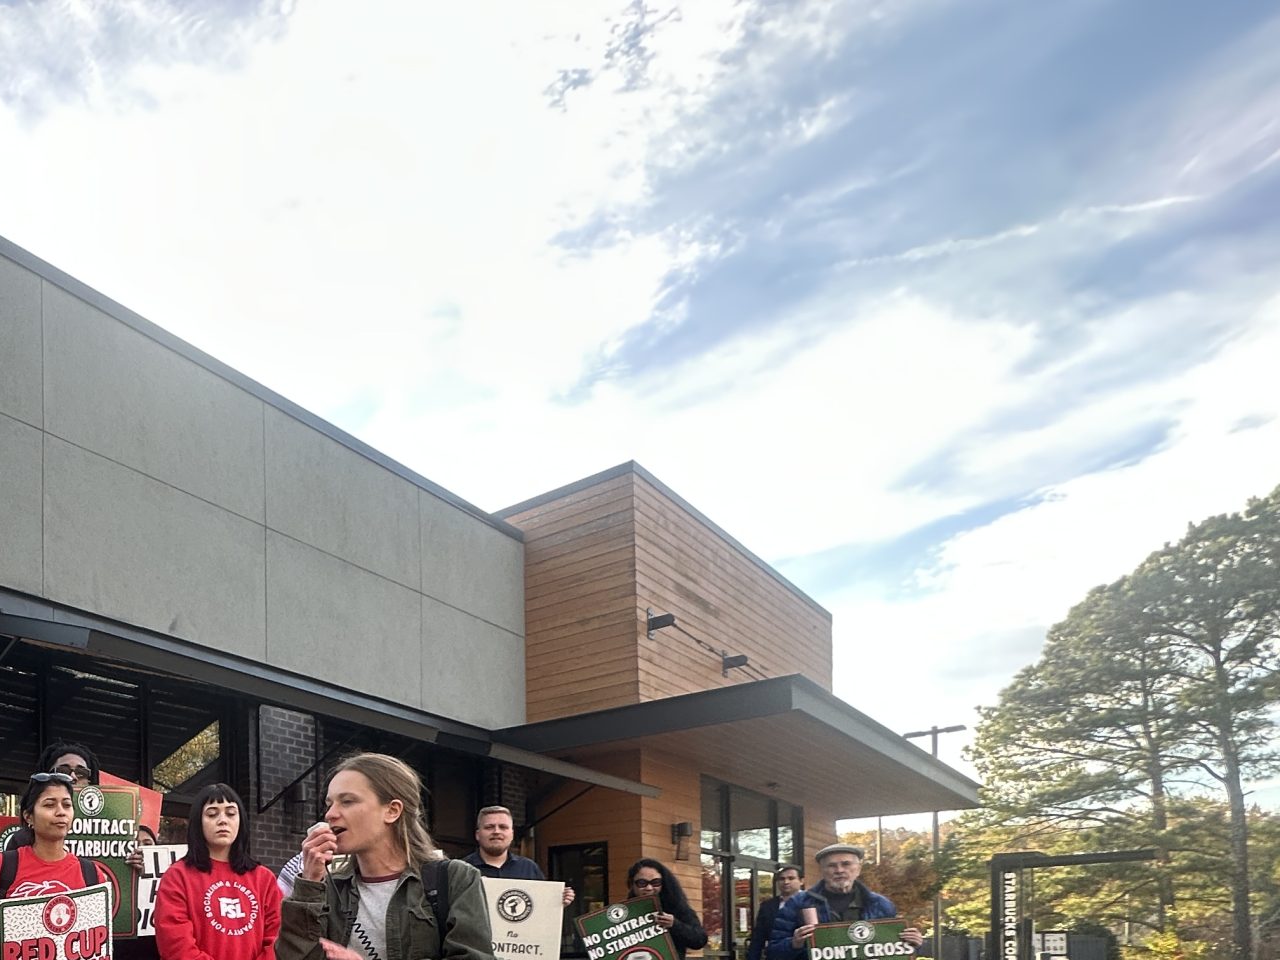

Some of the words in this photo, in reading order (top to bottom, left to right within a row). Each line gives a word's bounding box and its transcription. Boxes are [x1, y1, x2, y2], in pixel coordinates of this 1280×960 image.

[203, 880, 225, 918] SOCIALISM
[217, 897, 246, 919] PSL
[233, 881, 259, 925] LIBERATION
[1004, 872, 1017, 937] STARBUCKS
[227, 922, 254, 936] PARTY
[583, 933, 601, 948] NO
[602, 911, 659, 940] CONTRACT
[587, 946, 605, 960] NO
[811, 944, 859, 960] DON'T
[863, 941, 915, 957] CROSS
